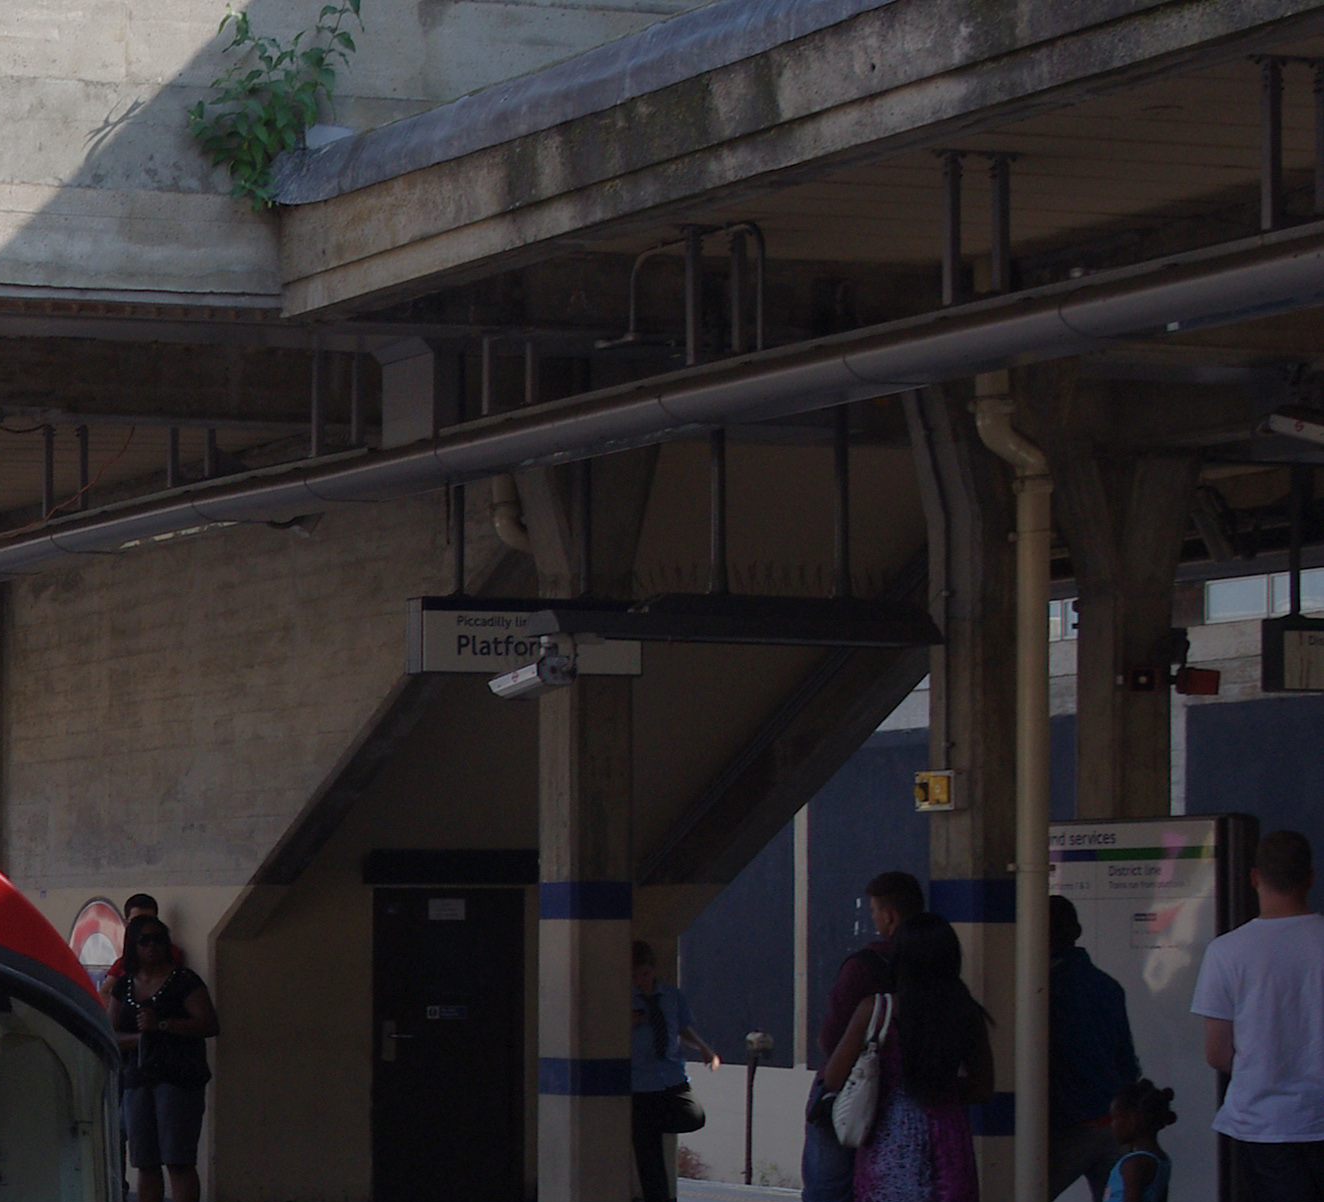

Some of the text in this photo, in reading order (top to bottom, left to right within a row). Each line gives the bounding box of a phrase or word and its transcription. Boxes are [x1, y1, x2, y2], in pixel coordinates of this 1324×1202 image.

[456, 615, 512, 630] Piccadilly
[1069, 830, 1116, 846] services
[1108, 865, 1142, 877] District
